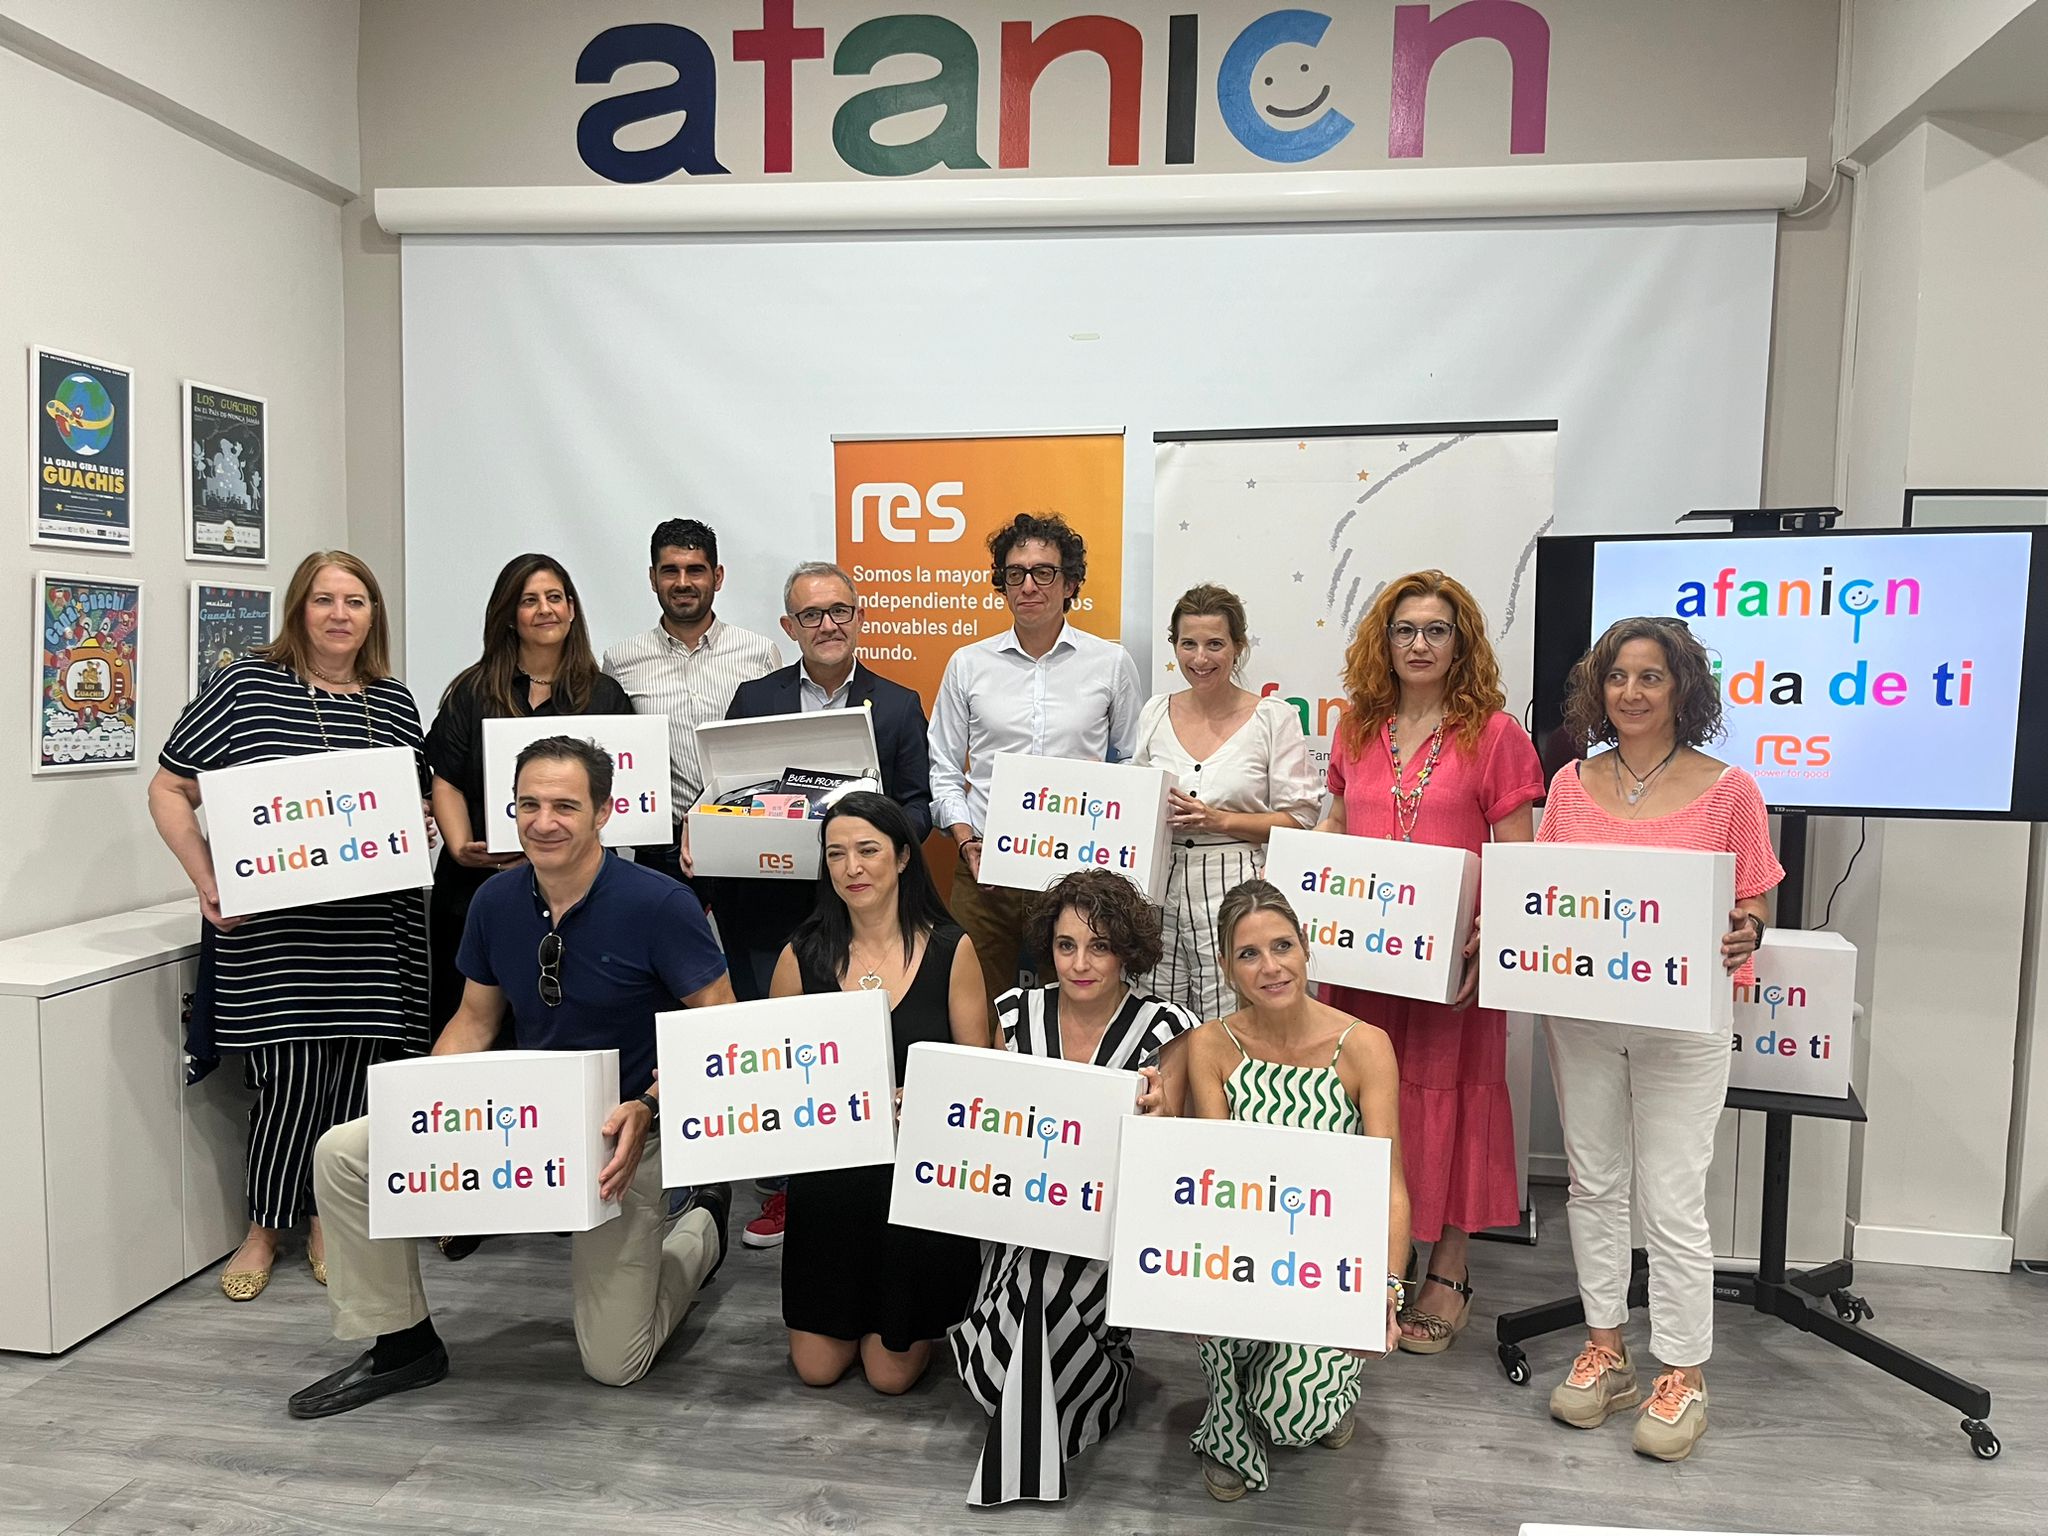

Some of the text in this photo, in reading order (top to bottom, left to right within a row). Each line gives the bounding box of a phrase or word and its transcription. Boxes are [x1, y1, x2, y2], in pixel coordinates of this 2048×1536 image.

[196, 392, 258, 417] LOS GUACHIS
[43, 456, 54, 466] LA
[55, 458, 78, 469] GRAN
[79, 462, 98, 472] GIRA
[110, 468, 124, 476] LOS
[43, 465, 125, 494] GUACHIS
[851, 481, 967, 543] res
[852, 565, 990, 587] Somos la mayor
[858, 592, 1005, 612] ndependiente de
[861, 618, 978, 636] enovables del
[853, 645, 917, 661] mundo.
[1828, 659, 1908, 707] de
[1931, 659, 1974, 707] ti
[1754, 733, 1832, 767] res
[787, 774, 814, 784] BUEN
[814, 776, 846, 788] PROVE
[639, 790, 656, 813] ti
[234, 830, 410, 878] cuida de ti
[758, 853, 794, 869] res
[997, 833, 1137, 869] cuida de ti
[1303, 918, 1435, 962] ida de ti
[1498, 944, 1688, 986] cuida de ti
[1755, 1030, 1797, 1057] de
[1809, 1034, 1831, 1060] ti
[682, 1091, 871, 1140] cuida de ti
[388, 1157, 566, 1195] cuida de ti
[915, 1160, 1104, 1213] cuida de ti
[1138, 1242, 1362, 1293] cuida de ti
